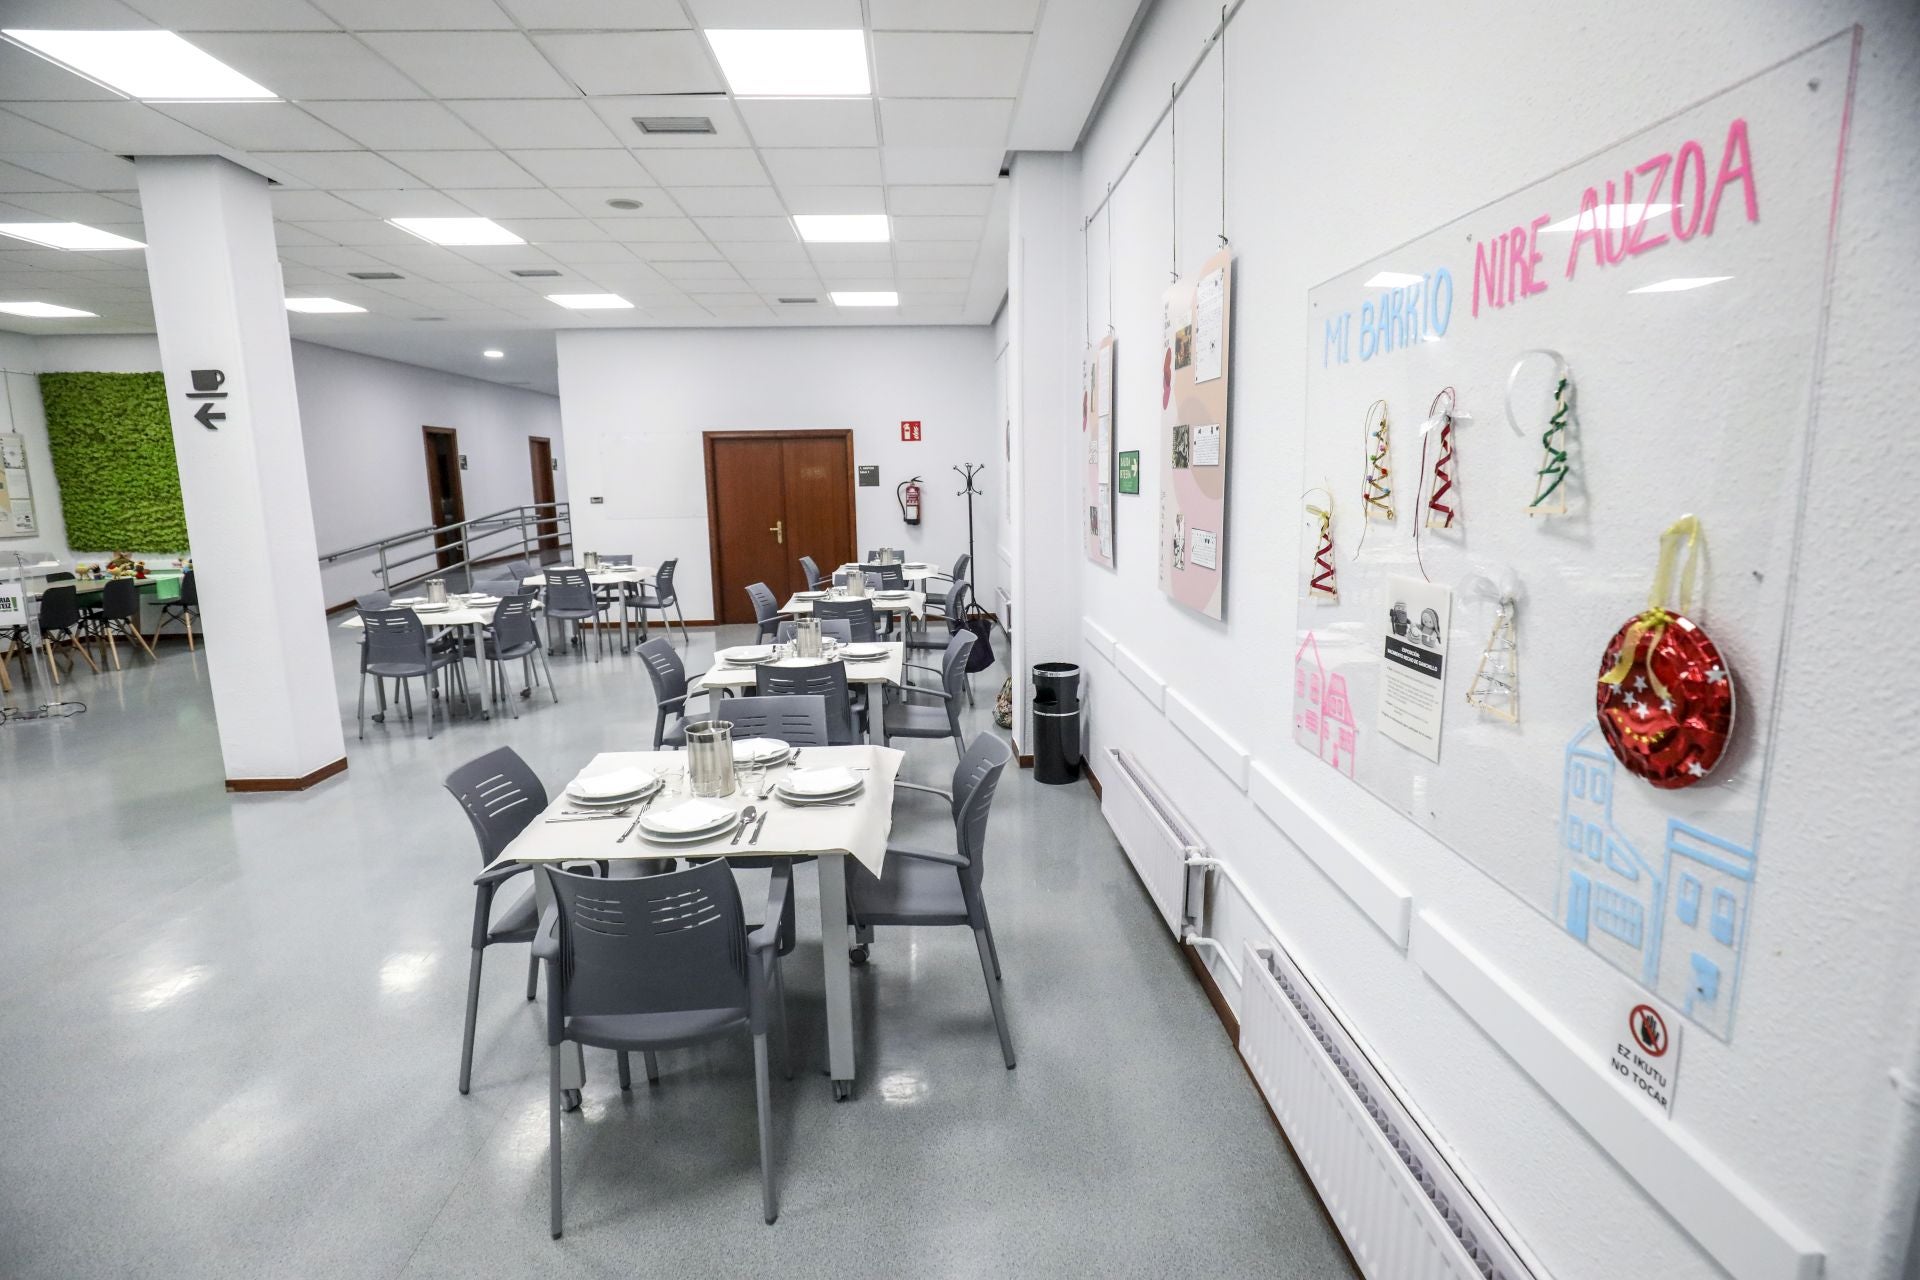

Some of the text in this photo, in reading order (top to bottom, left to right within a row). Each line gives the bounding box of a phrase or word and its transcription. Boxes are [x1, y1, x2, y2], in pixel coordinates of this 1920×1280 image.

[1471, 117, 1760, 318] NIRE AUZOA
[1324, 267, 1454, 370] MI BARRIO
[1611, 1057, 1668, 1110] NO TOCAR
[1617, 1043, 1667, 1088] EZ IKUTU
